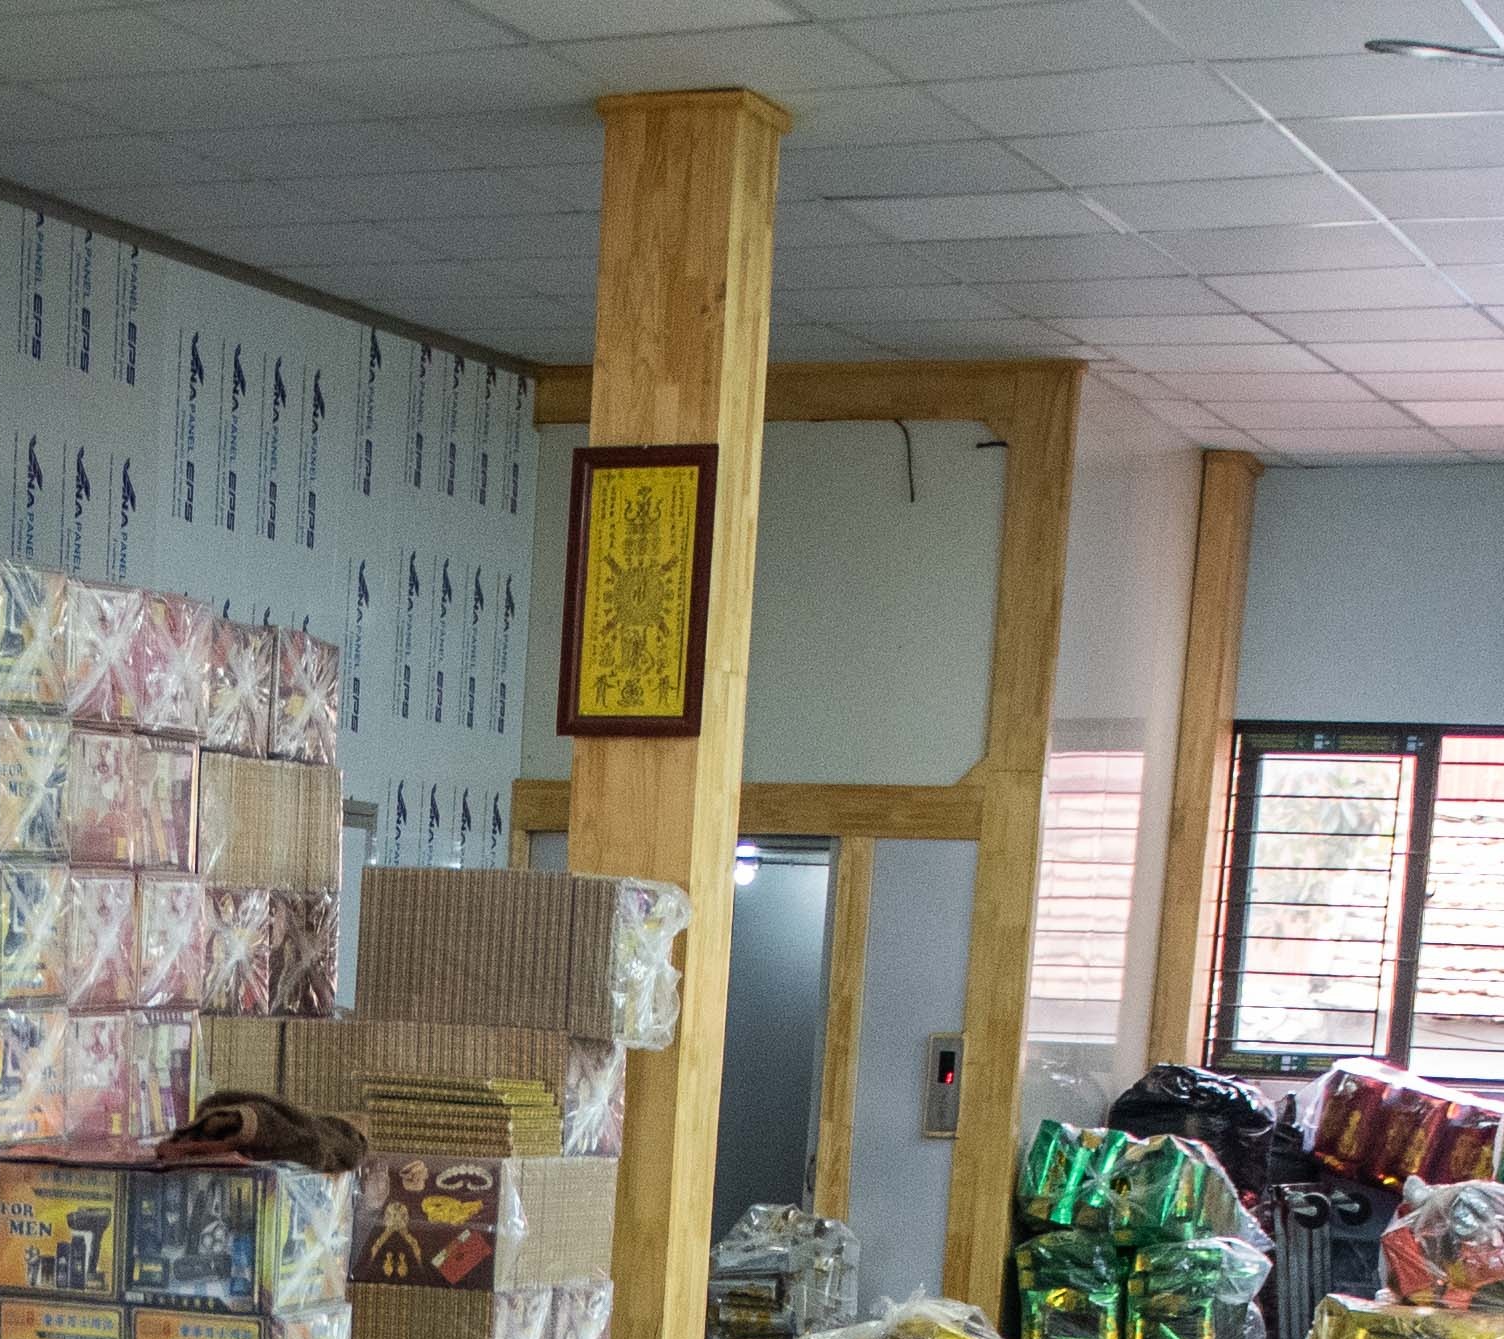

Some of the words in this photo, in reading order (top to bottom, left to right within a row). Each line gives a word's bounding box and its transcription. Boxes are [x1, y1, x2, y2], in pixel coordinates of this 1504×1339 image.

[32, 293, 43, 361] EPS
[80, 308, 91, 374] EPS
[126, 321, 137, 387] EPS
[363, 439, 373, 496] EPS
[414, 432, 423, 489] EPS
[447, 442, 456, 496] EPS
[480, 452, 488, 506] EPS
[510, 462, 519, 514] EPS
[184, 461, 195, 523] EPS
[227, 470, 237, 532] EPS
[267, 481, 277, 541] EPS
[307, 491, 316, 549] EPS
[351, 677, 360, 733] EPS
[402, 664, 411, 719] EPS
[435, 671, 443, 723] EPS
[467, 677, 475, 730] EPS
[498, 682, 506, 734] EPS
[0, 1202, 33, 1217] FOR
[9, 1219, 52, 1236] MEN
